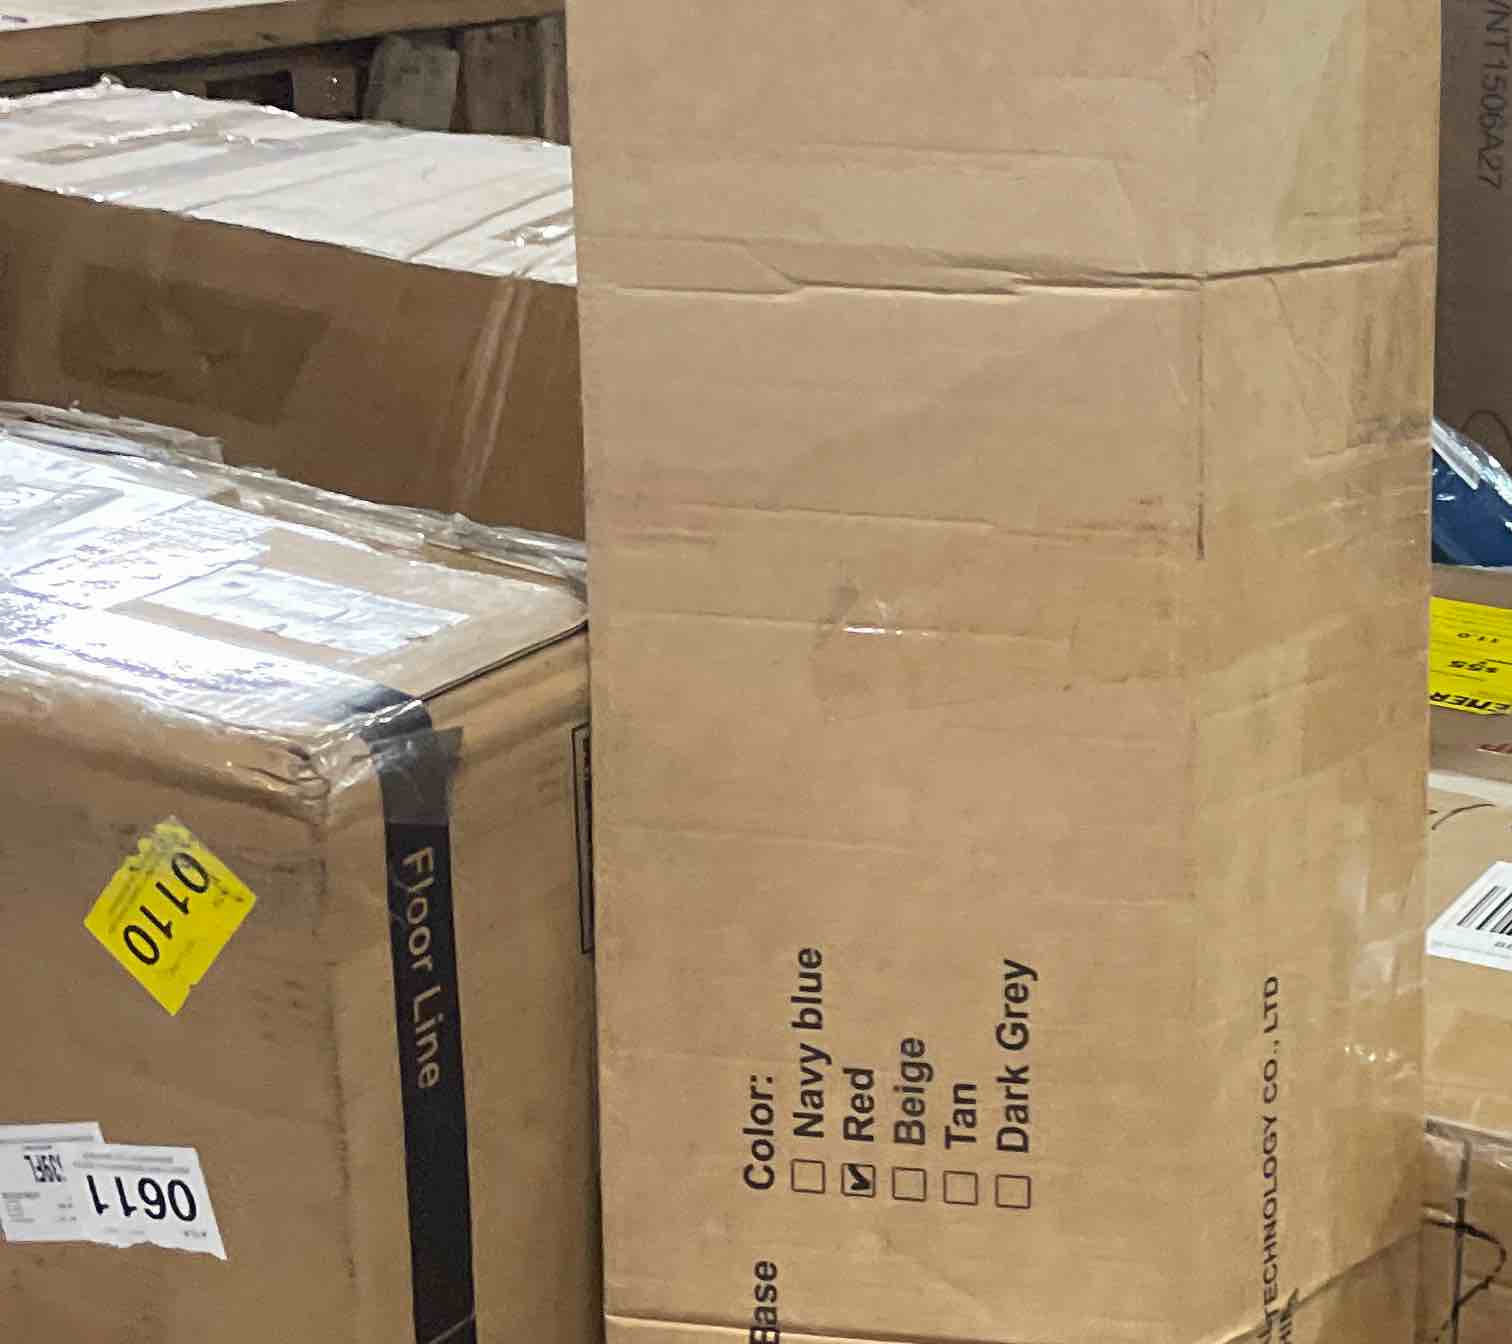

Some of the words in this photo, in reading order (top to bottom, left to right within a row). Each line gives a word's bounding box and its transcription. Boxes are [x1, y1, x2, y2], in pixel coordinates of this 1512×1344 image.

[122, 851, 211, 965] 0110
[400, 846, 435, 971] Floor
[790, 946, 824, 1031] blue
[996, 958, 1038, 1051] Grey
[1263, 974, 1280, 1034] LTD
[408, 985, 442, 1090] Line
[743, 1074, 776, 1191] Color:
[793, 1042, 832, 1139] Navy
[842, 1067, 875, 1143] Red
[893, 1036, 934, 1146] Beige
[944, 1081, 978, 1150] Tan
[996, 1064, 1030, 1153] Dark
[86, 1174, 198, 1223] 0611
[1261, 1114, 1281, 1328] TECHNOLOGY
